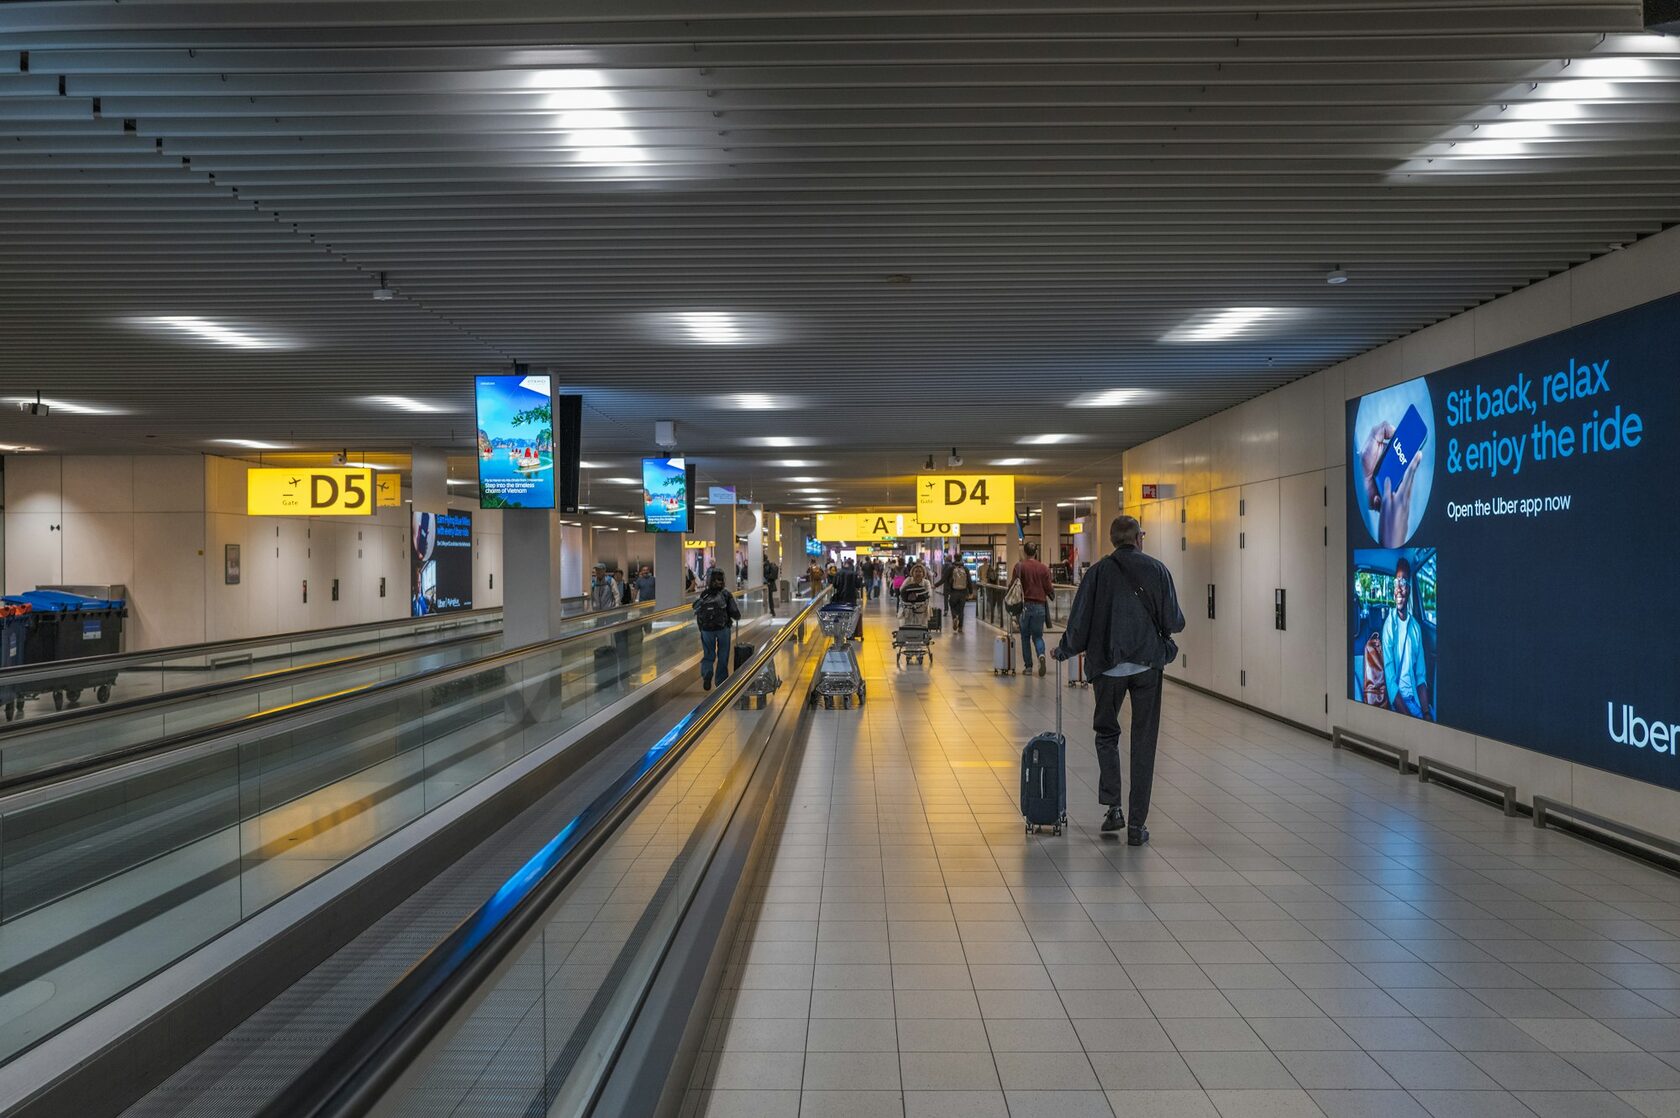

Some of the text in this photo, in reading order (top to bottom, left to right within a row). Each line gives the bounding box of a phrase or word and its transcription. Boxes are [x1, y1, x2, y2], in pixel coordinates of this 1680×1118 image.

[1447, 358, 1610, 427] Sit back, relax
[1393, 437, 1408, 465] Uber
[1447, 405, 1643, 477] & enjoy the ride
[311, 474, 365, 508] D5
[944, 479, 989, 505] D4
[1447, 495, 1571, 521] Open the Uber app now
[872, 516, 889, 534] A
[1607, 701, 1680, 755] Uber
